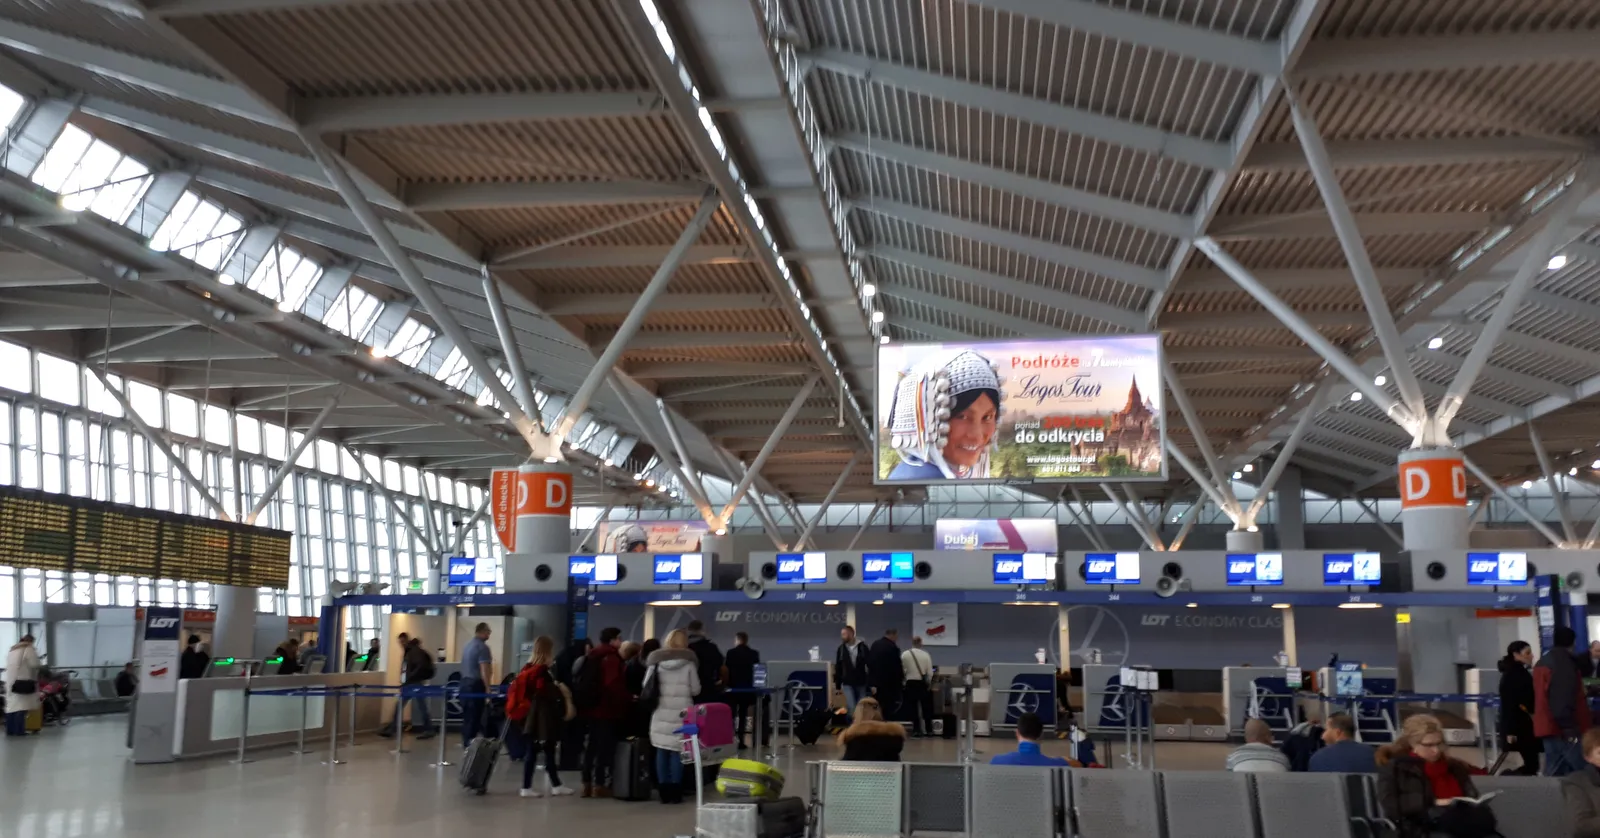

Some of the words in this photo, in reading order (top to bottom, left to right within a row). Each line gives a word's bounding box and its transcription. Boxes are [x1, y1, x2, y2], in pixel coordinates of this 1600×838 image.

[1011, 353, 1080, 369] Podróże
[1091, 348, 1104, 368] 7
[1013, 374, 1064, 406] Logos
[1063, 374, 1101, 399] Tour
[1015, 420, 1040, 430] ponad
[1015, 429, 1036, 443] do
[1038, 427, 1105, 445] odkrycia
[1026, 454, 1096, 465] www.logostour.pl
[1405, 467, 1431, 500] D
[498, 471, 509, 512] check-in
[545, 478, 567, 508] D
[497, 512, 507, 532] Self
[943, 532, 979, 546] Dubaj
[450, 564, 475, 575] LOT
[570, 562, 596, 574] LOT
[655, 561, 681, 573] LOT
[778, 560, 804, 572] LOT
[865, 560, 891, 572] LOT
[995, 561, 1022, 573] LOT
[1088, 560, 1115, 573] LOT
[1229, 561, 1255, 574] LOT
[1327, 561, 1353, 574] LOT
[1470, 561, 1498, 573] LOT
[148, 617, 180, 628] LOT
[715, 611, 743, 622] LOT
[745, 611, 808, 623] ECONOMY
[810, 611, 847, 623] CLASS
[1141, 614, 1171, 626] LOT
[1175, 615, 1246, 628] ECONOMY
